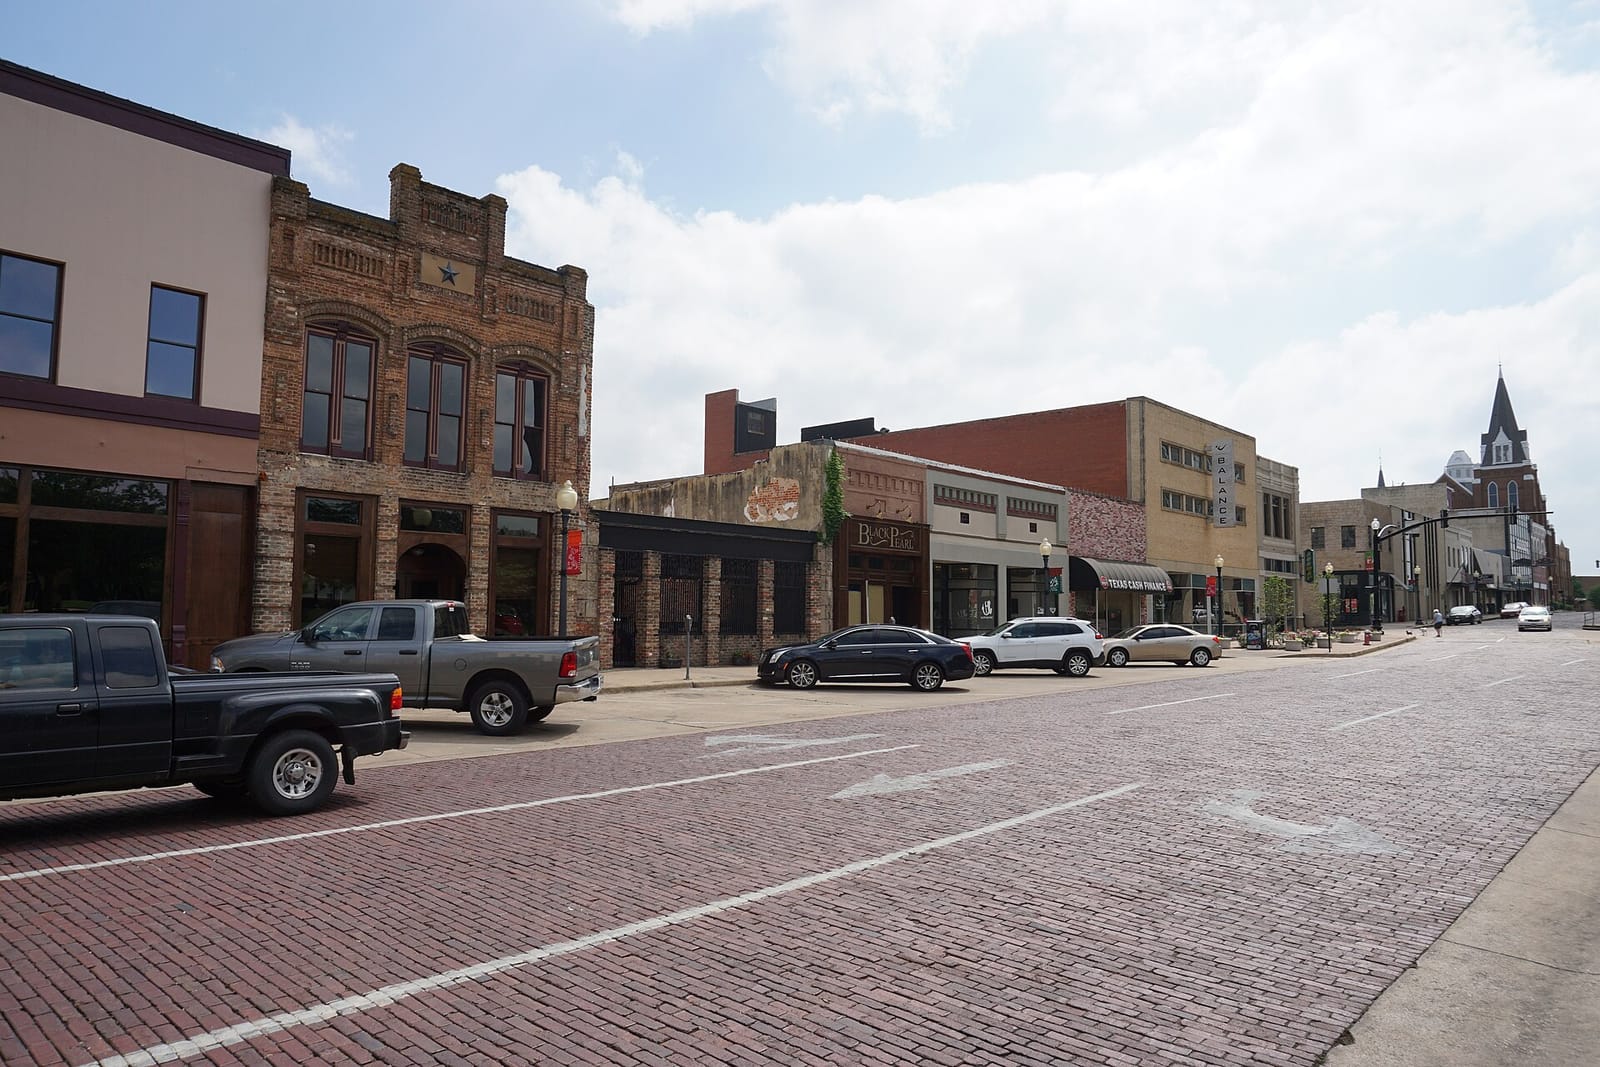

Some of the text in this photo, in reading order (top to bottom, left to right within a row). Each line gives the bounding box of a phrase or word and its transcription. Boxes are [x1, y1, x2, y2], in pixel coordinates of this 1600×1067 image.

[1218, 457, 1227, 524] BALANCE
[858, 523, 914, 549] BLACK PEARL
[1108, 579, 1128, 589] TEXAS
[1128, 580, 1143, 590] CASH
[1144, 581, 1166, 591] FINANCE
